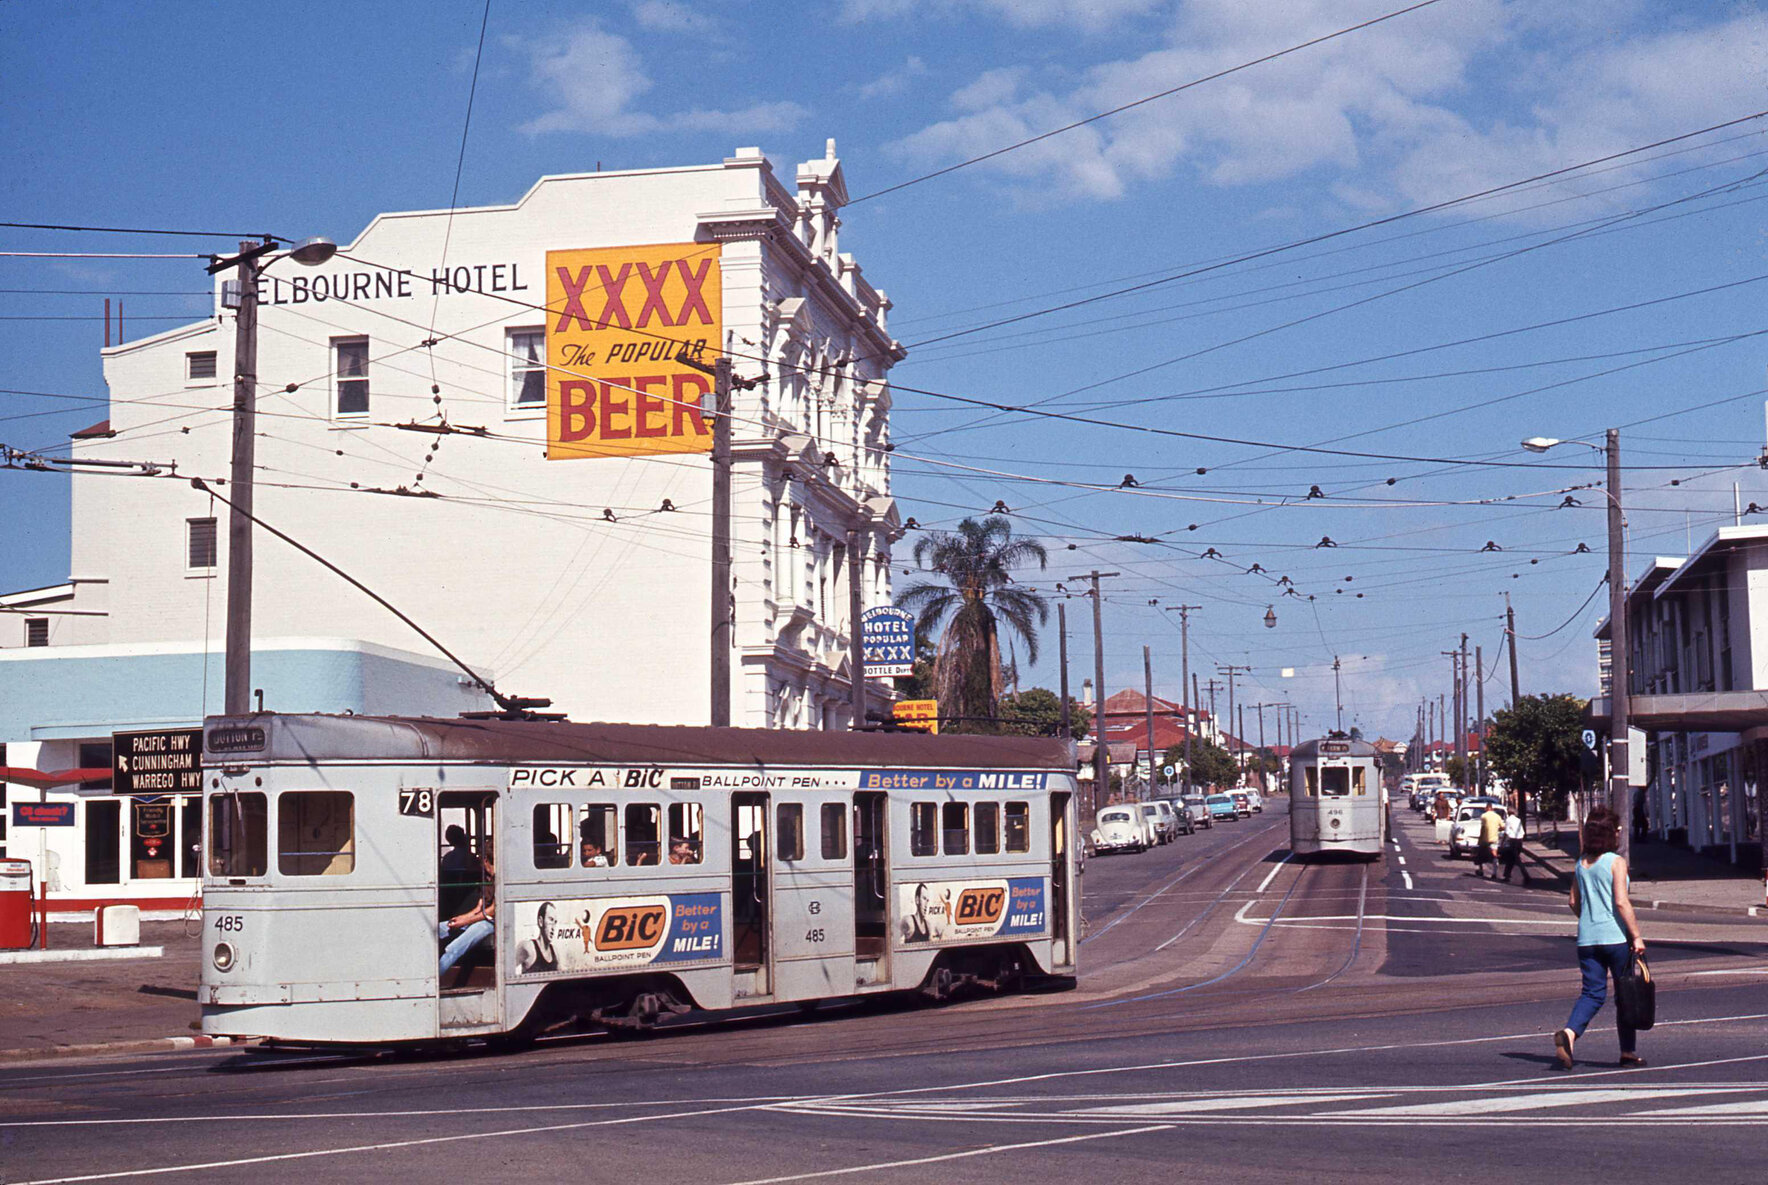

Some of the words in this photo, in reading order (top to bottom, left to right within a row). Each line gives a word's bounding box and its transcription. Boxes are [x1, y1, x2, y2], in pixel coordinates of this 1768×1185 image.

[256, 270, 412, 305] ELBOURNE
[432, 263, 528, 295] HOTEL
[555, 258, 714, 333] XXXX
[559, 343, 596, 367] The
[605, 339, 707, 364] POPULAR
[558, 373, 711, 442] BEER
[864, 621, 909, 633] HOTEL
[863, 635, 909, 643] POPULAR
[863, 646, 911, 660] XXXX
[133, 736, 166, 752] PACIFIC
[171, 735, 190, 750] HWY
[132, 754, 192, 770] CUNNINGHAM
[132, 773, 174, 789] WARREGO
[181, 772, 201, 787] HWY
[511, 769, 577, 786] PICK
[588, 771, 606, 786] A
[702, 776, 786, 787] BALLPOINT
[868, 774, 928, 788] Better
[935, 774, 956, 790] by
[962, 777, 973, 788] a
[978, 773, 1042, 789] MILE!
[400, 791, 432, 813] 78
[1012, 887, 1041, 897] Better
[675, 904, 717, 917] Better
[1016, 901, 1028, 911] by
[215, 916, 243, 932] 485
[681, 920, 697, 934] by
[700, 920, 710, 930] a
[1010, 912, 1043, 927] MILE!
[557, 928, 574, 939] PICK
[574, 928, 581, 939] A
[805, 929, 824, 942] 485
[673, 934, 719, 953] MILE!
[595, 953, 635, 963] BALLPOINT
[637, 951, 651, 959] PEN
